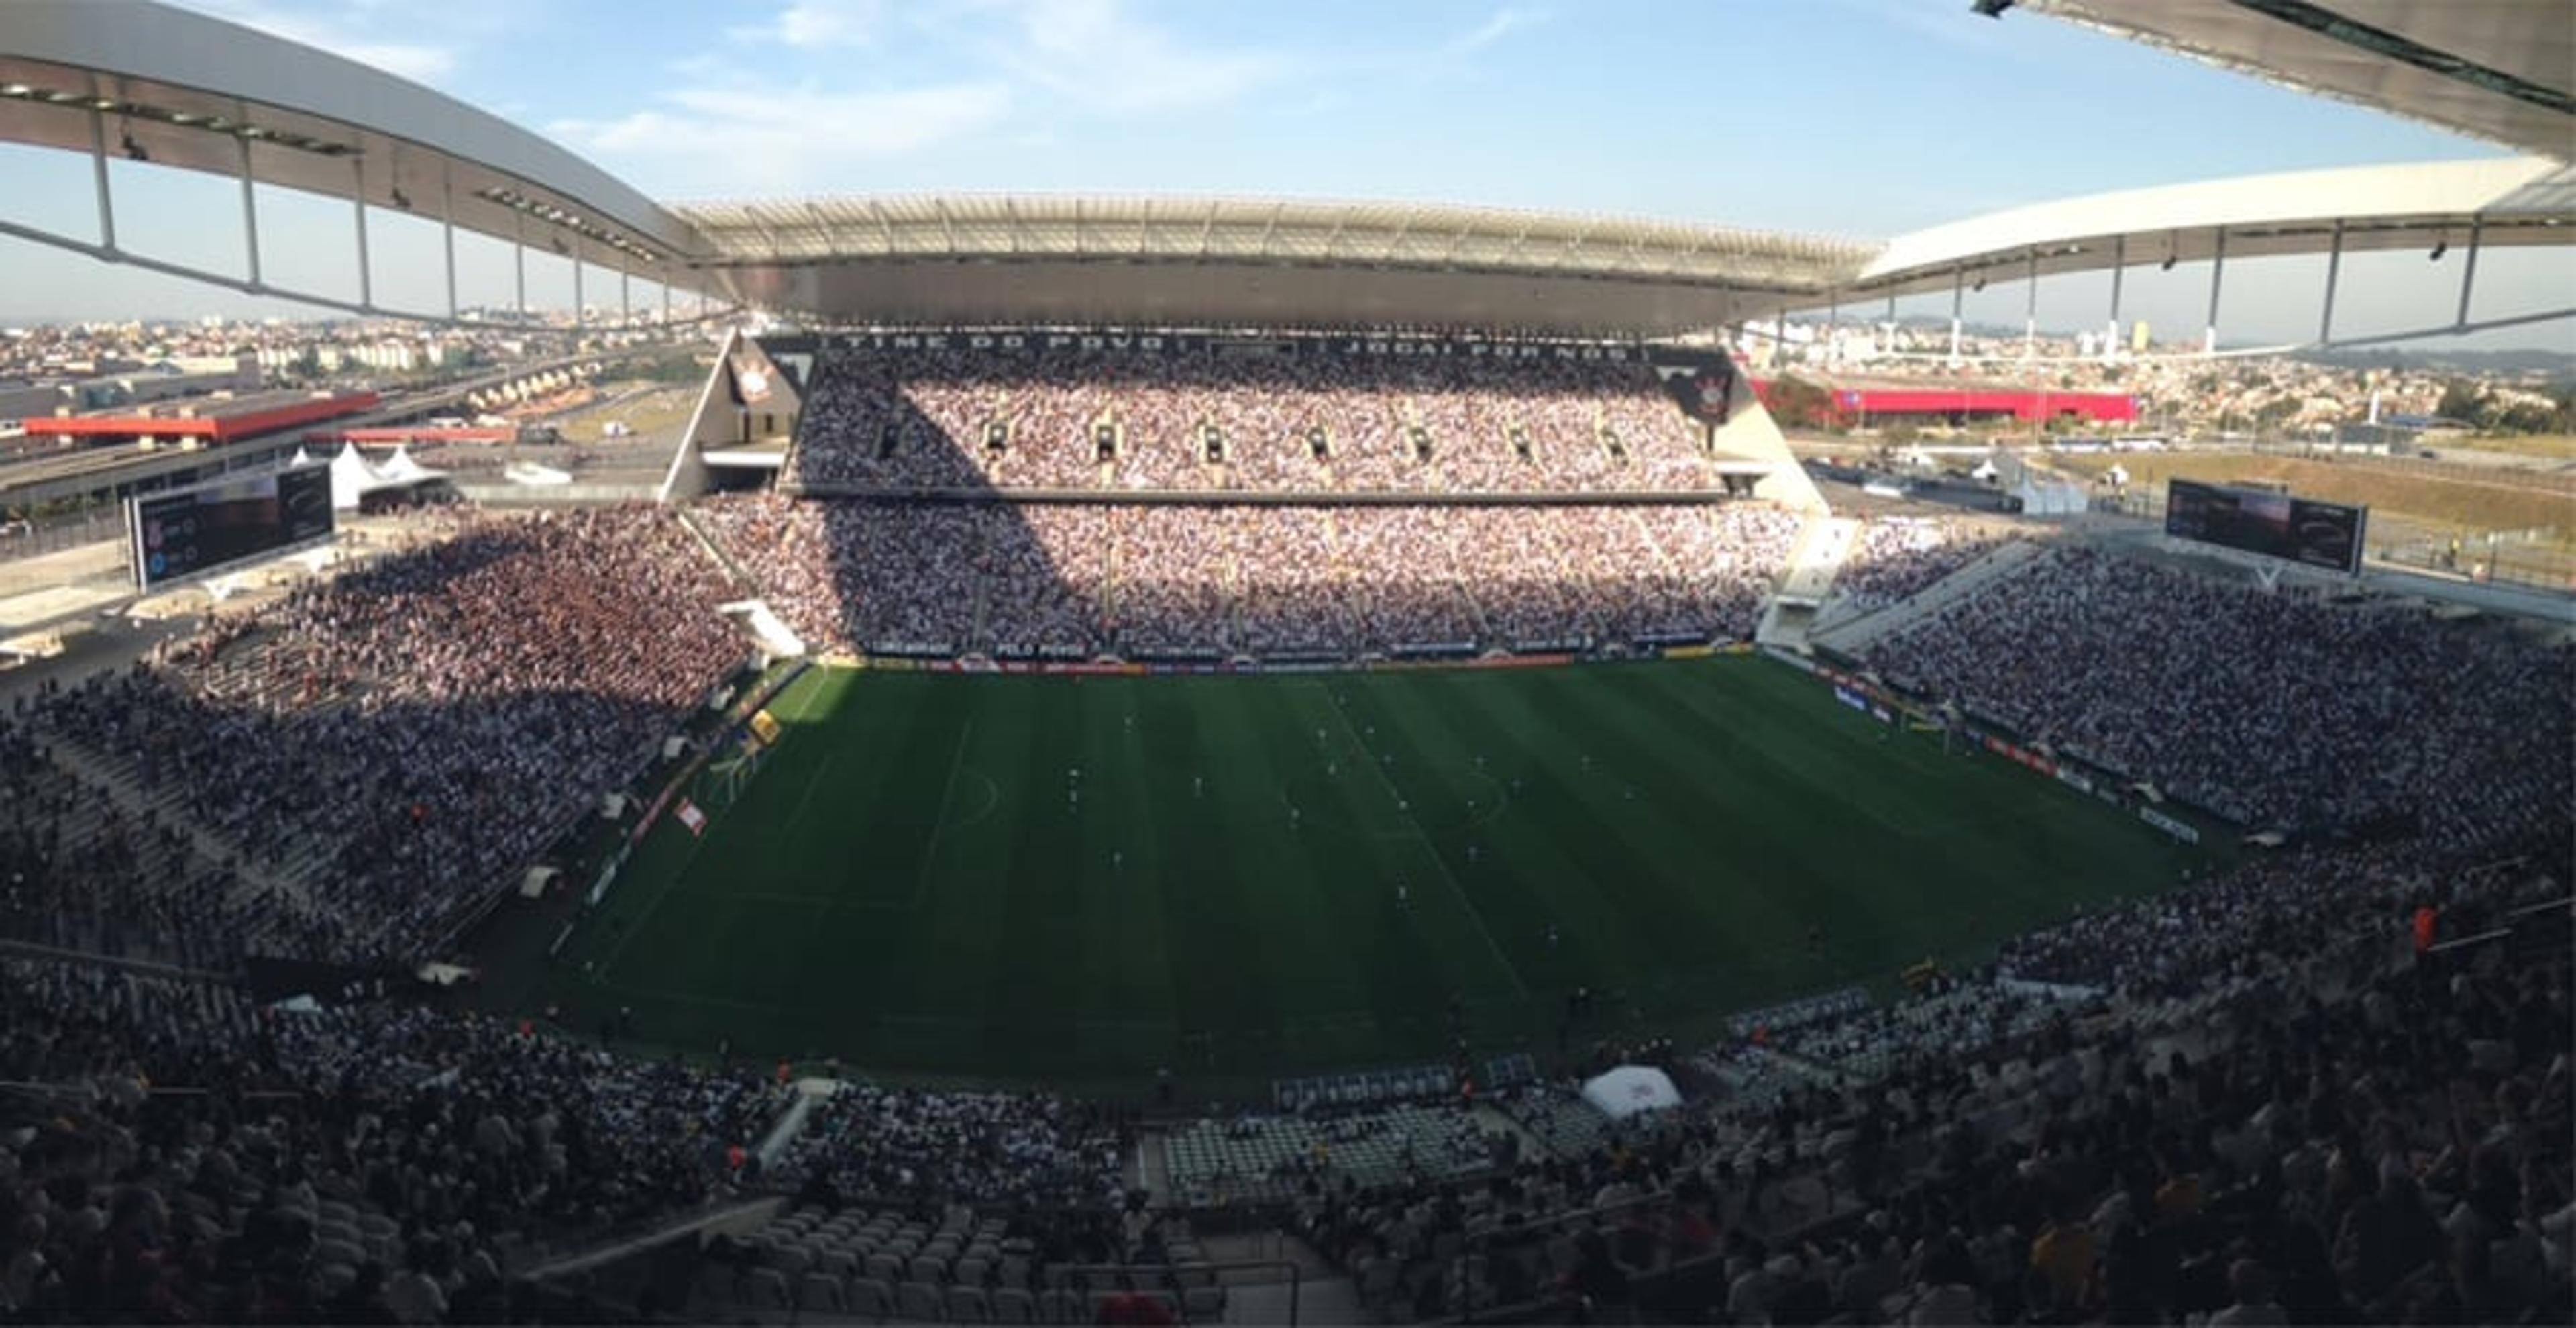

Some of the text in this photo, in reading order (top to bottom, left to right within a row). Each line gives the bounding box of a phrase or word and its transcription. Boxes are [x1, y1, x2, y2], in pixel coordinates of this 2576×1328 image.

[844, 336, 1163, 348] TIME DO POVO
[1344, 342, 1452, 354] JOGAI
[1471, 344, 1538, 357] POR
